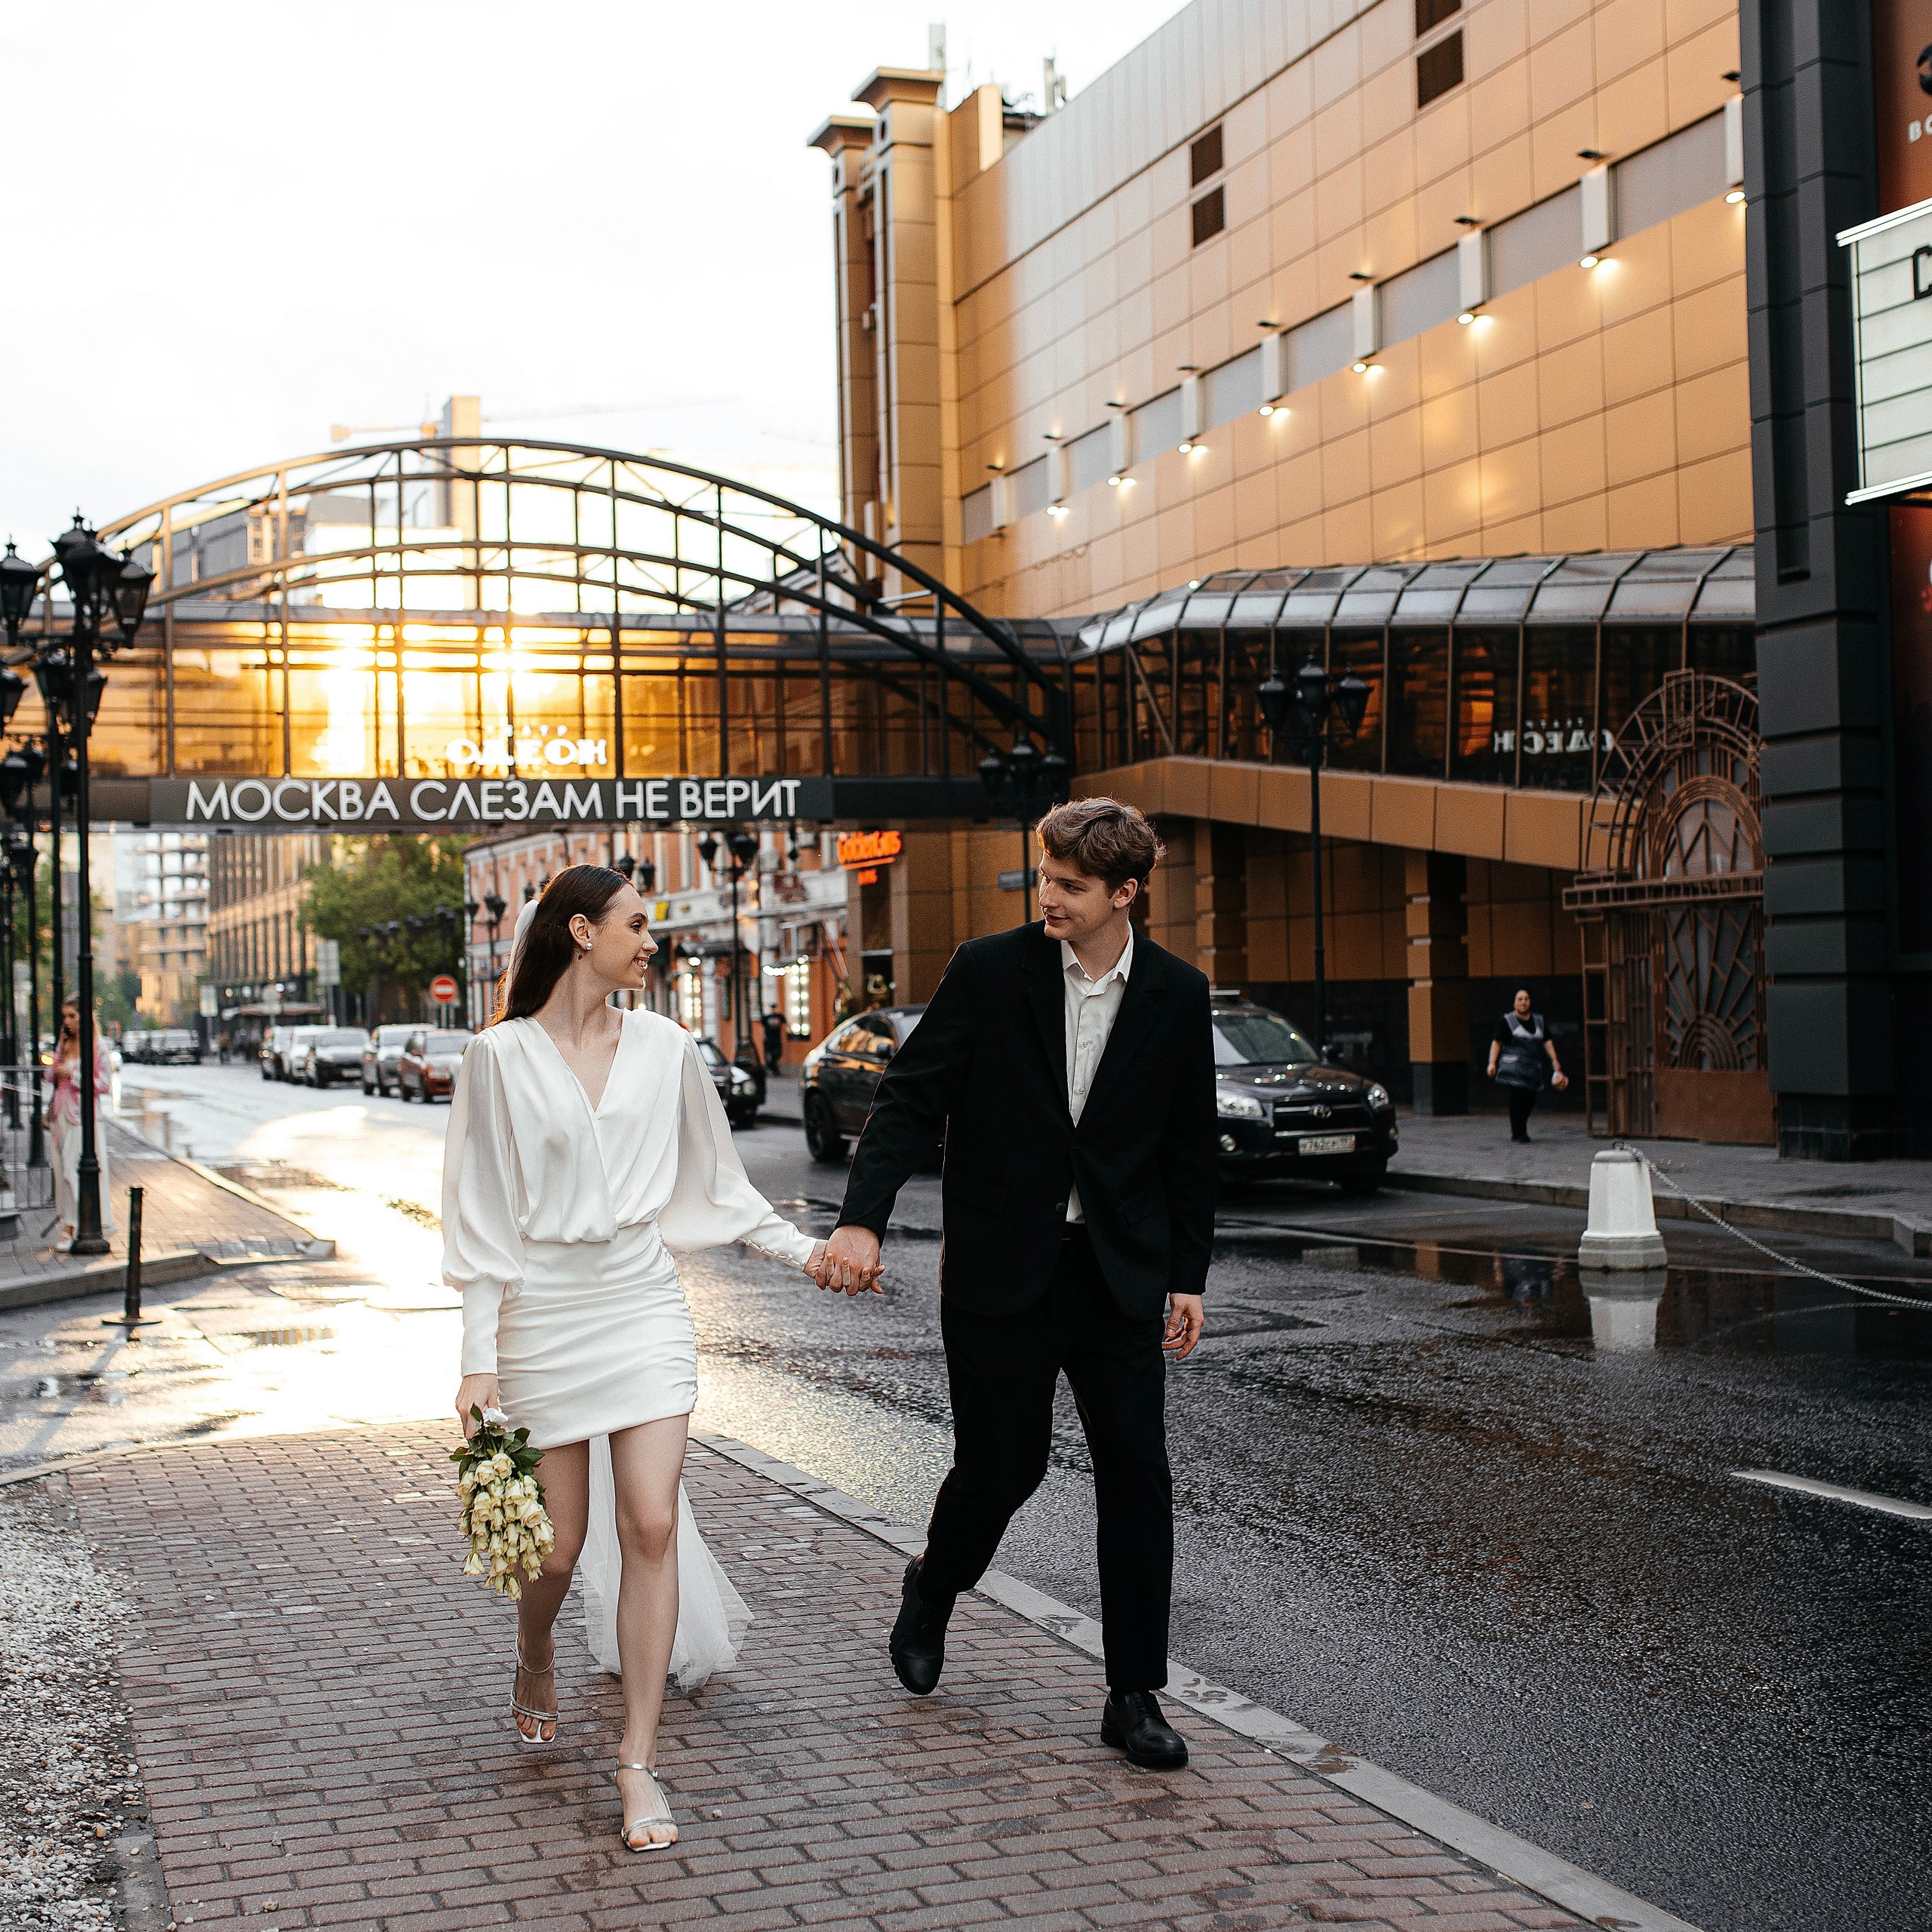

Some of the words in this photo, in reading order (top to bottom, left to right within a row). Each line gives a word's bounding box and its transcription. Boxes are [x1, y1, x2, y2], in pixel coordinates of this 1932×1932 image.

[445, 738, 608, 766] ОДЕОН
[186, 779, 401, 821] МОСКВА
[410, 780, 604, 820] СЛЕЗАМ
[615, 780, 669, 819] НЕ
[680, 779, 801, 819] ВЕРИТ
